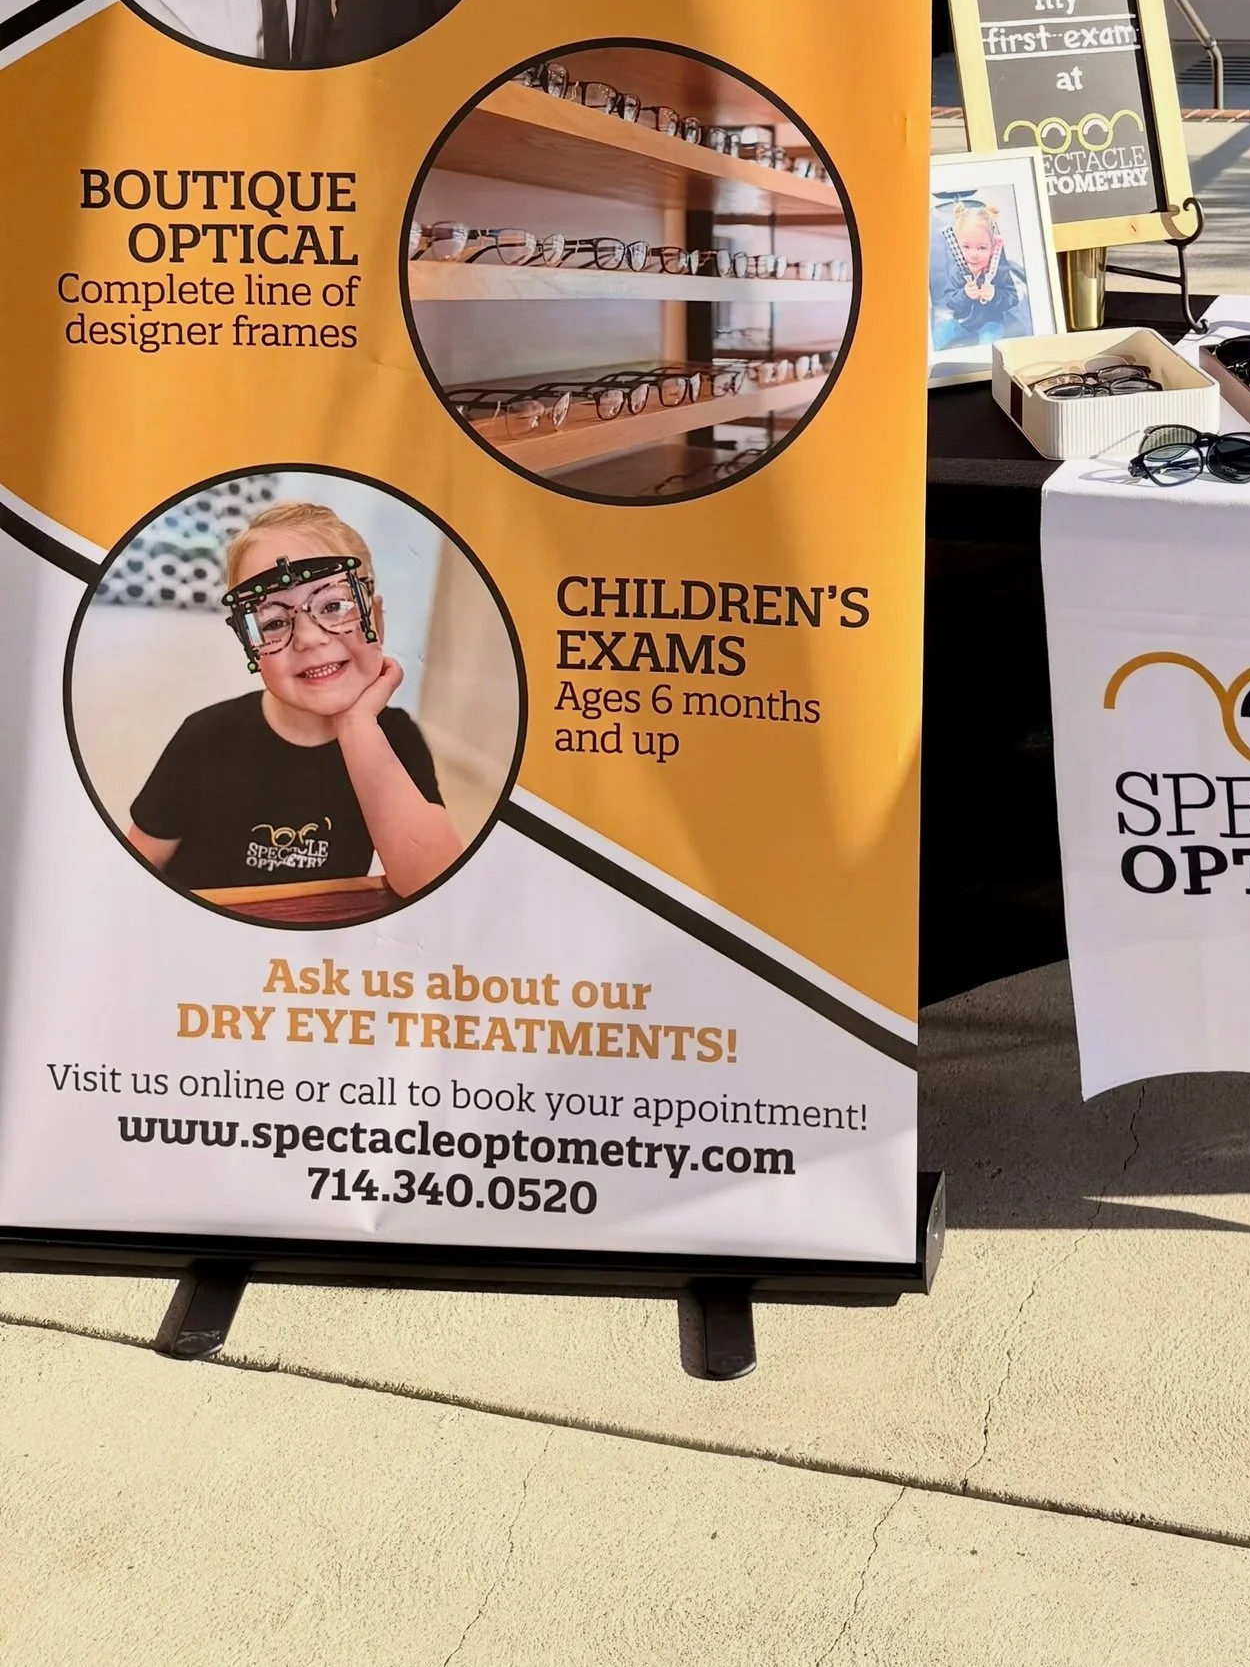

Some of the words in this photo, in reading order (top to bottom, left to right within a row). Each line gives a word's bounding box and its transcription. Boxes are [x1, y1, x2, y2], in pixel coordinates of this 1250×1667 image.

[984, 24, 1050, 54] first
[1063, 24, 1139, 49] exam
[1055, 66, 1084, 92] at
[1042, 146, 1147, 177] ECTACLE
[1046, 167, 1148, 196] TOMETRY
[80, 169, 355, 217] BOUTIQUE
[129, 223, 358, 265] OPTICAL
[59, 273, 234, 311] Complete
[245, 274, 311, 306] line
[323, 276, 361, 306] of
[66, 313, 222, 353] designer
[233, 315, 357, 348] frames
[557, 630, 745, 676] EXAMS
[554, 681, 640, 719] Ages
[652, 684, 672, 714] 6
[683, 690, 820, 723] months
[555, 723, 623, 753] and
[633, 732, 679, 763] up
[263, 958, 350, 995] Ask
[362, 970, 414, 998] us
[427, 965, 560, 1006] about
[572, 981, 651, 1010] our
[177, 1003, 275, 1040] DRY
[287, 1008, 375, 1045] EYE
[388, 1012, 737, 1063] TREATMENTS!
[47, 1063, 121, 1093] Visit
[132, 1074, 168, 1095] us
[180, 1070, 284, 1100] online
[296, 1081, 329, 1102] or
[340, 1077, 396, 1105] call
[408, 1082, 440, 1107] to
[451, 1080, 535, 1112] book
[545, 1093, 623, 1121] your
[634, 1094, 866, 1130] appointment!
[117, 1113, 798, 1179] www.spectacleoptometry.com
[308, 1167, 597, 1214] 714.340.0520
